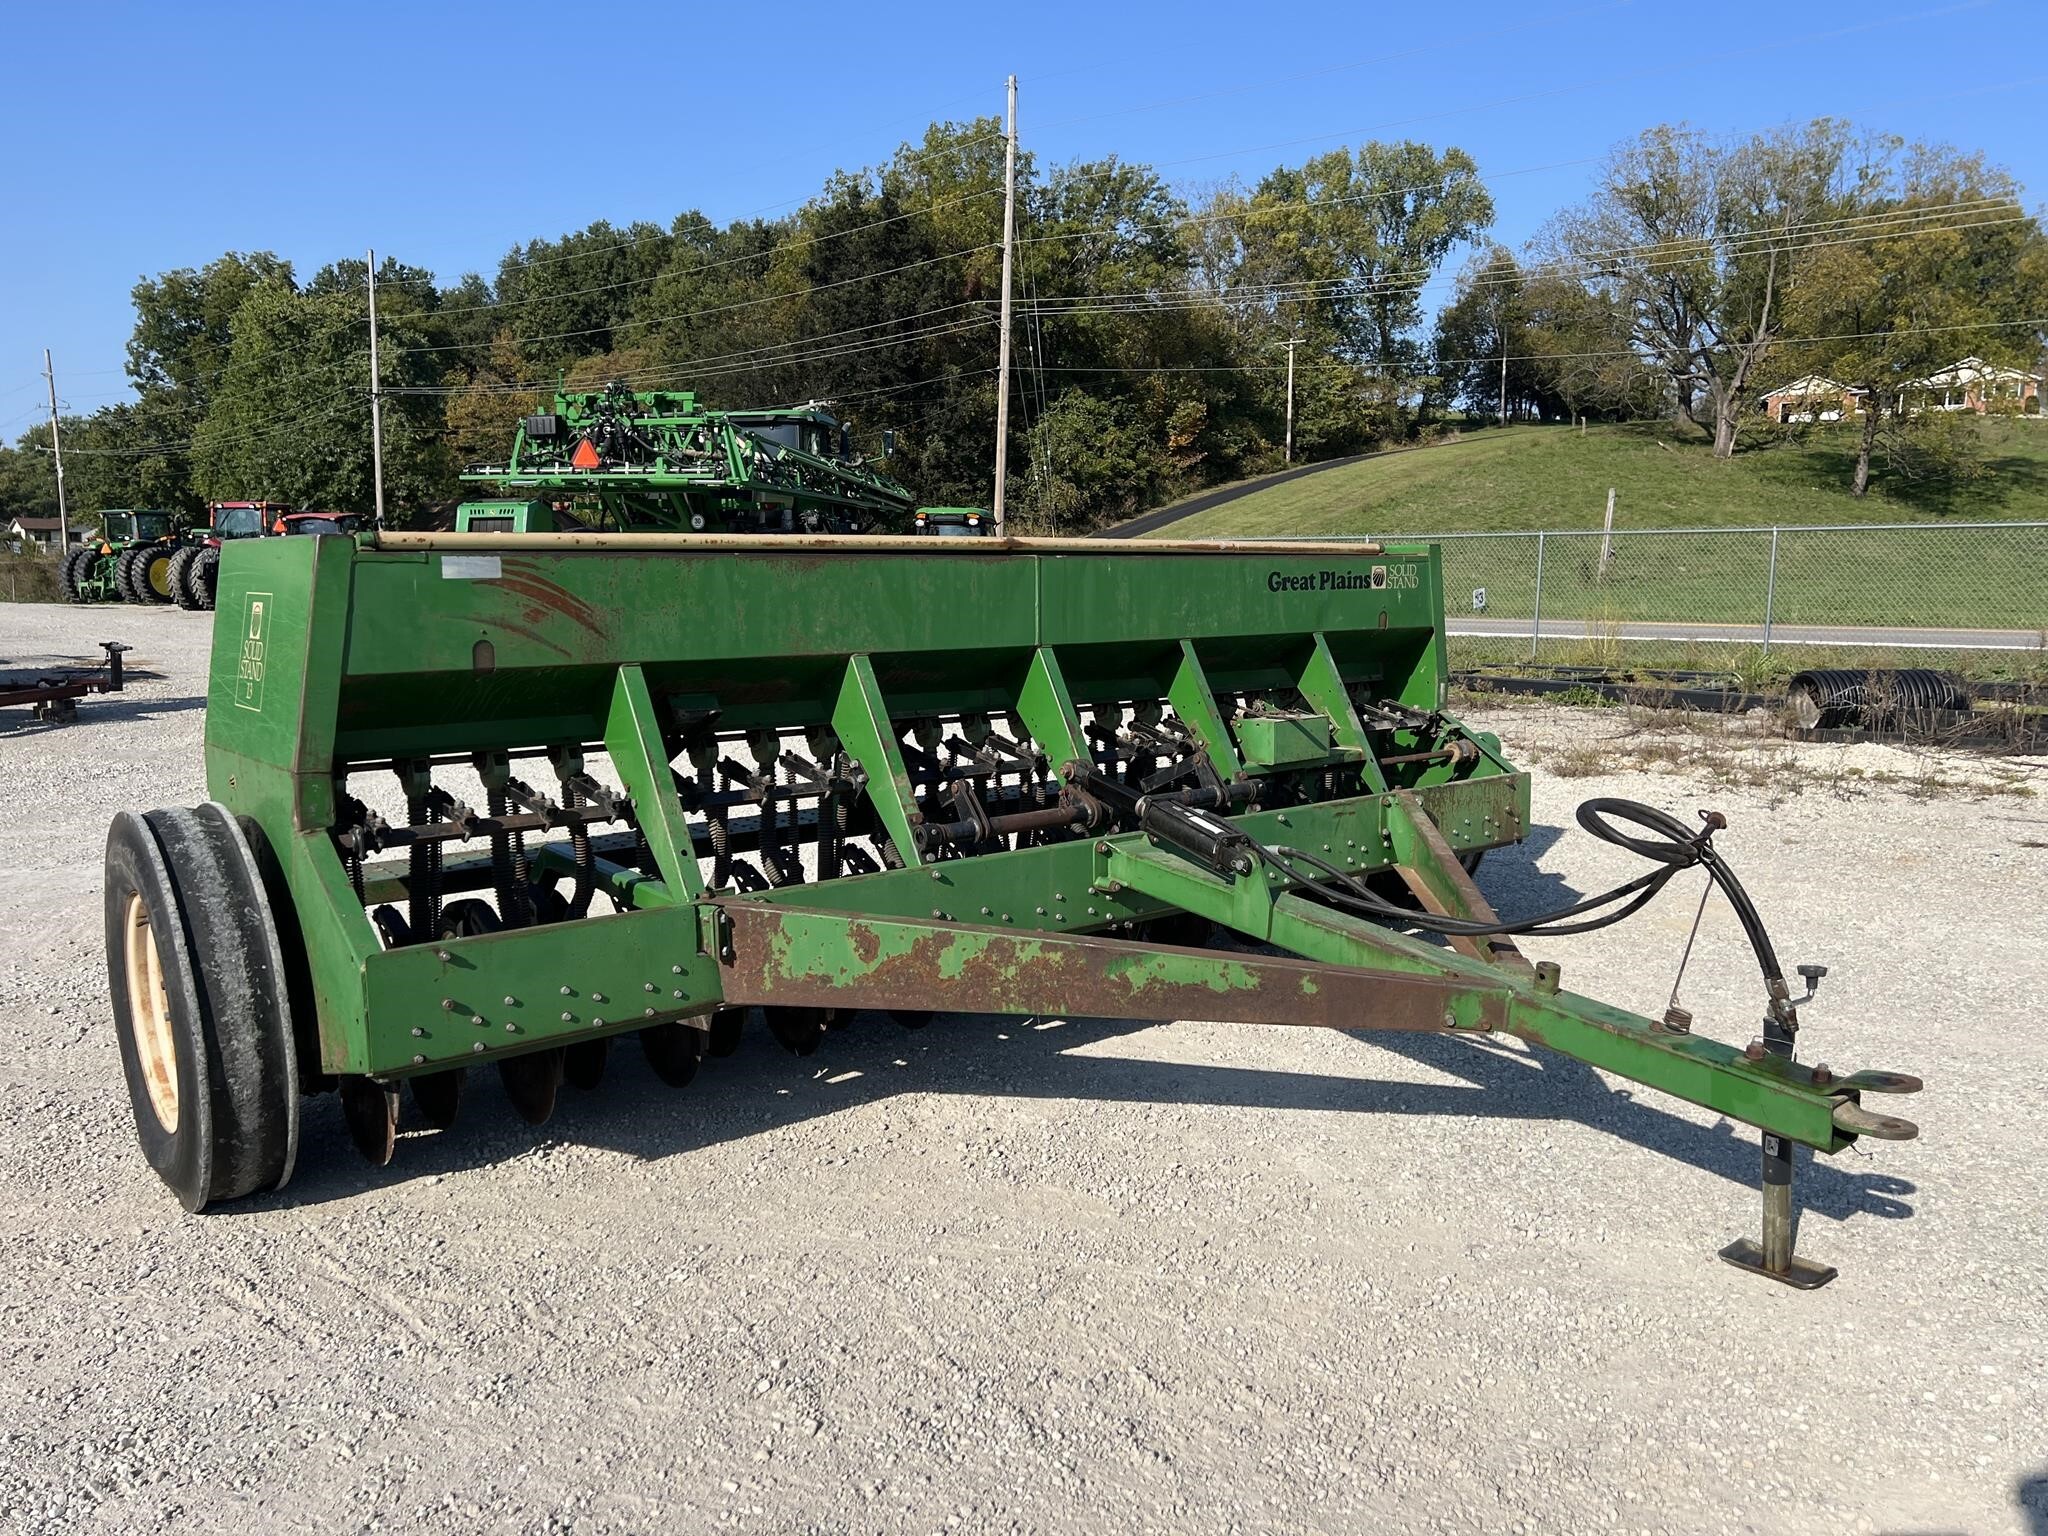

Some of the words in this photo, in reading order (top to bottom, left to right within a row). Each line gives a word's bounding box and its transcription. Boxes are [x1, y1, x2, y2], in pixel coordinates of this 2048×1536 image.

[1389, 564, 1417, 576] SOLID
[1268, 571, 1316, 592] Great
[1319, 571, 1371, 590] Plains
[1387, 576, 1419, 589] STAND
[243, 640, 263, 661] SOLID
[240, 660, 263, 681] STAND
